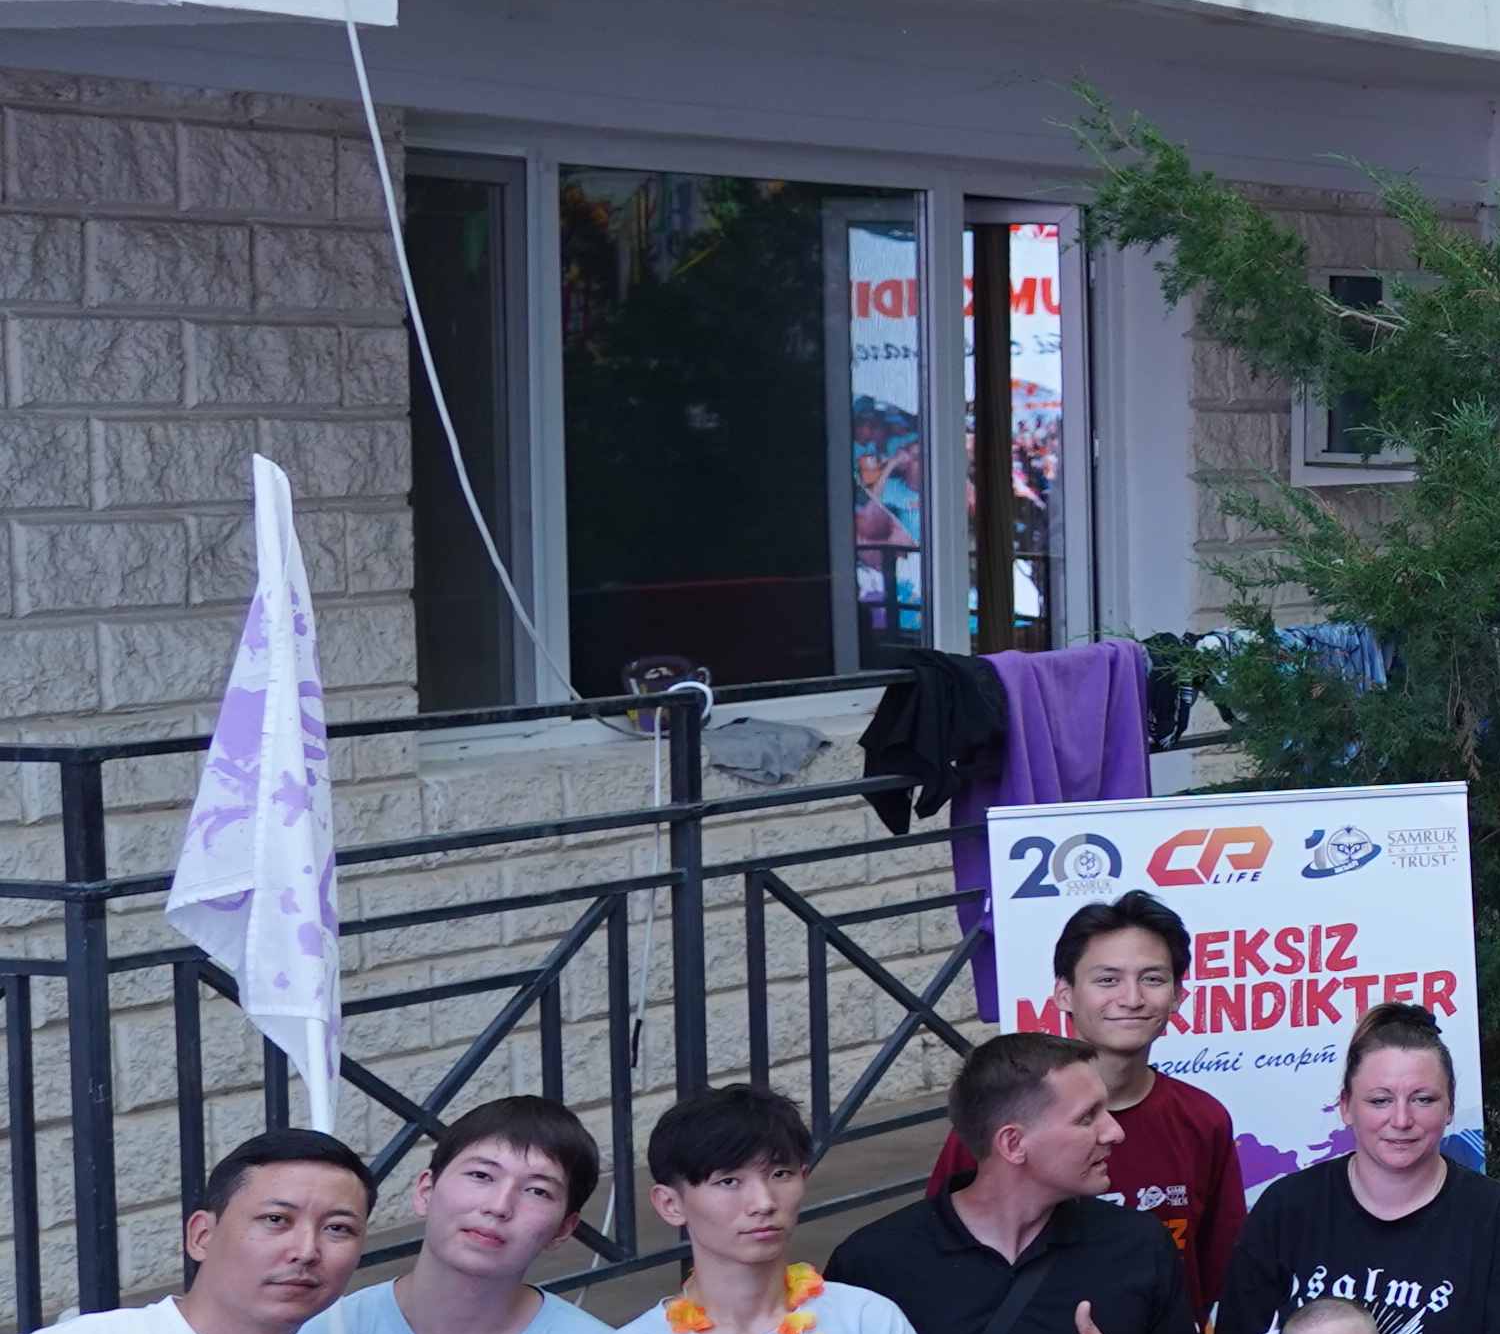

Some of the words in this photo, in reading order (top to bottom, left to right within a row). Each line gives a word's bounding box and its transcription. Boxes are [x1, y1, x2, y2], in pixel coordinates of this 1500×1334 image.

[1387, 828, 1457, 844] SAMRUK
[1397, 854, 1450, 869] TRUST
[1213, 871, 1263, 884] LIFE
[1182, 923, 1359, 983] EKSIZ
